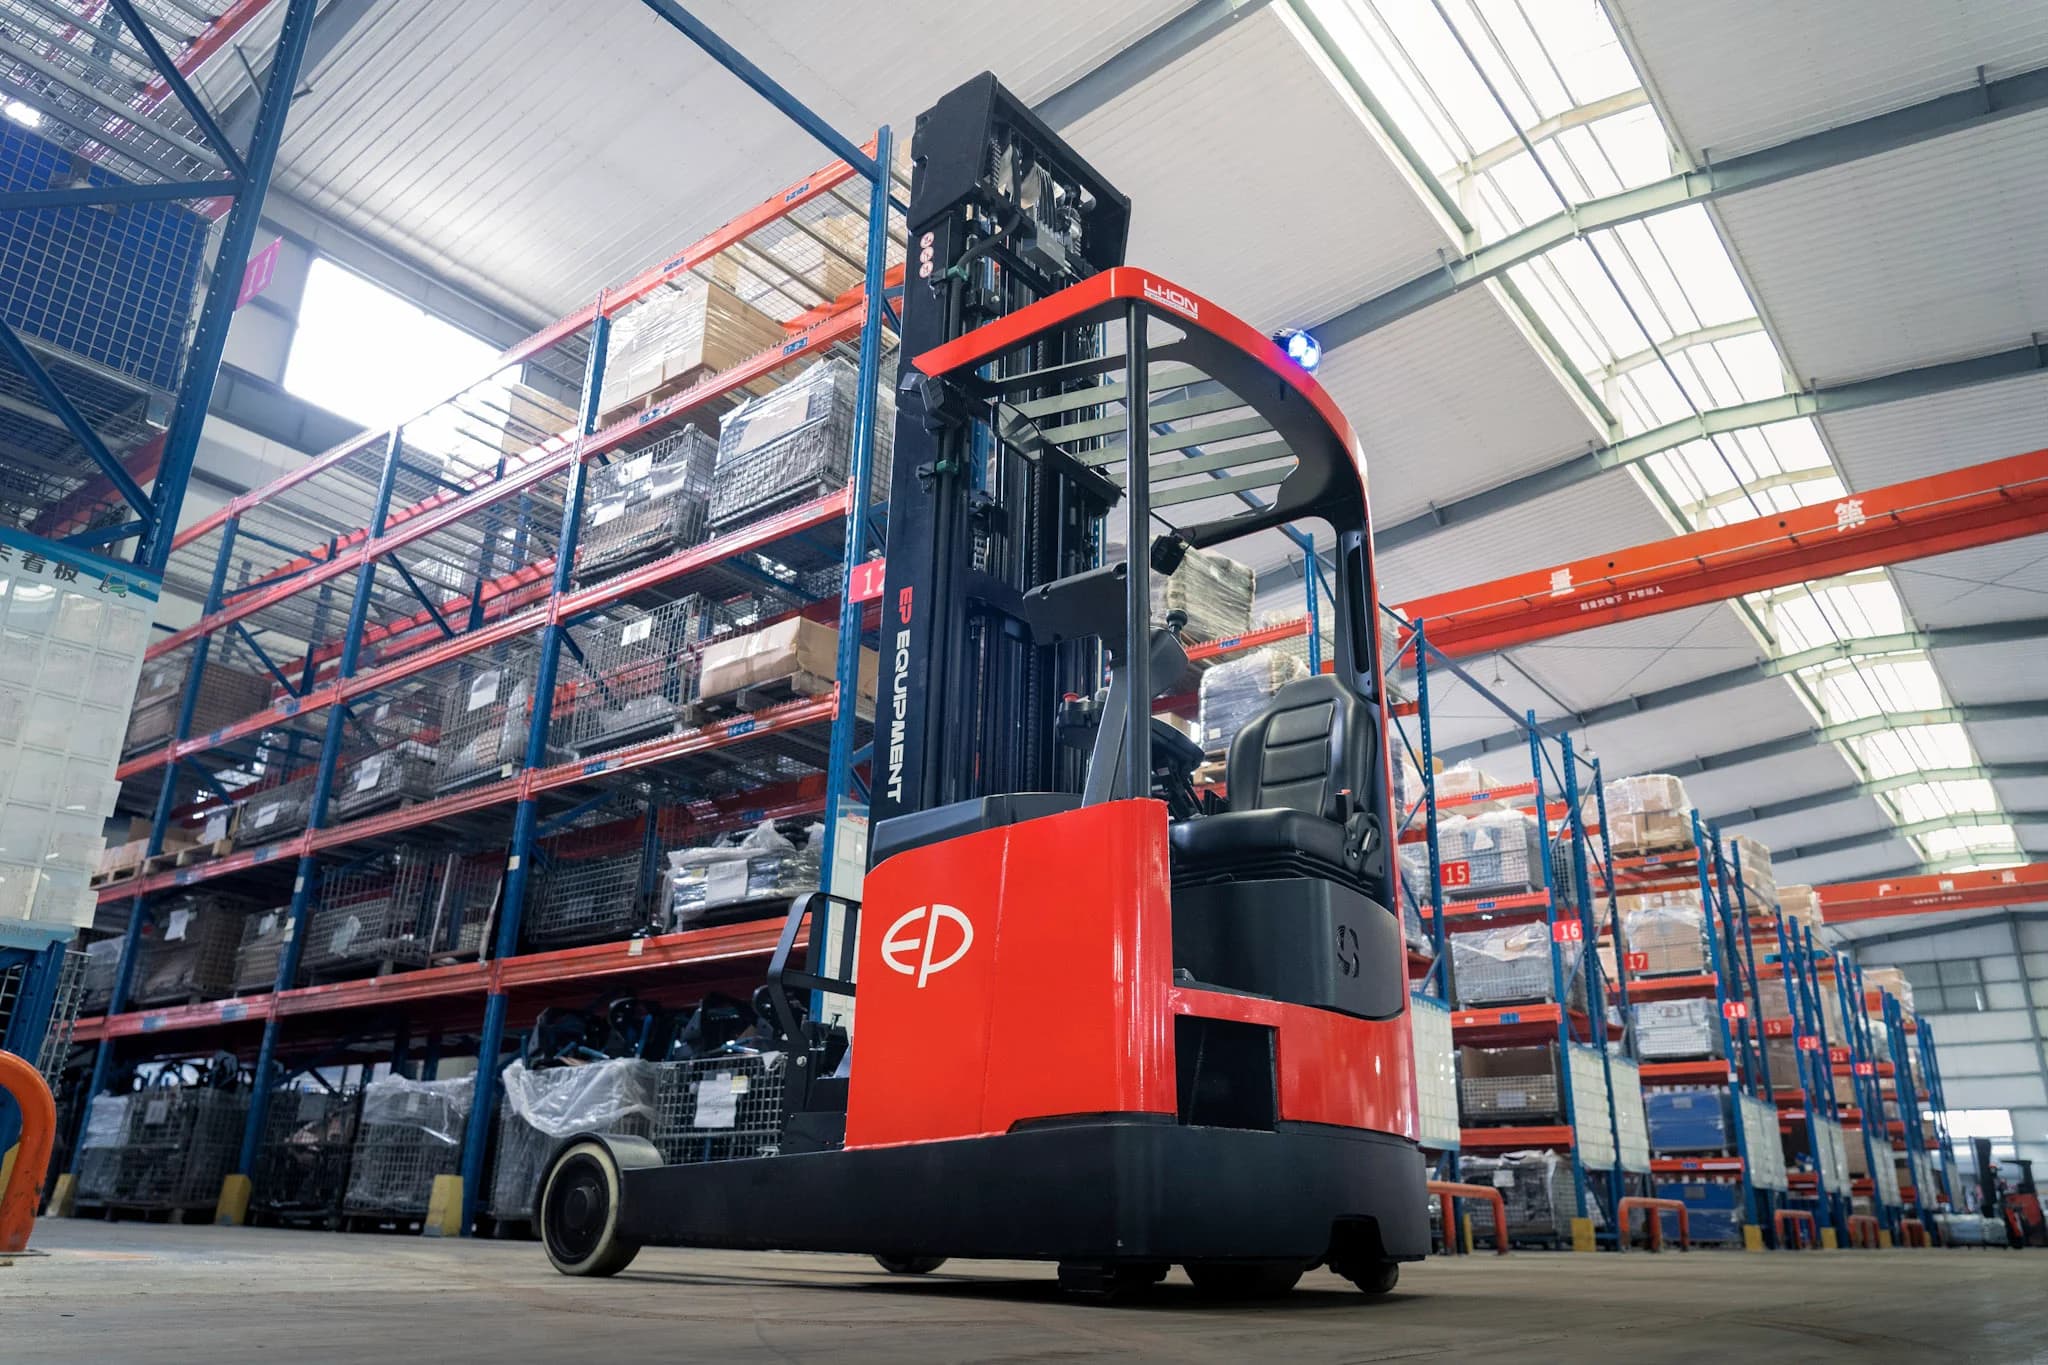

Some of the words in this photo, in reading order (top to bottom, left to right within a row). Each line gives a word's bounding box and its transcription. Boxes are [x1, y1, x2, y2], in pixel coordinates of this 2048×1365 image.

[1143, 278, 1199, 316] LI-ION
[1834, 499, 1867, 534] 第
[898, 586, 914, 625] EP
[886, 629, 911, 805] EQUIPMENT
[1445, 864, 1468, 885] 15
[1559, 922, 1581, 940] 16
[881, 903, 974, 989] EP
[1627, 956, 1646, 970] 17
[1729, 1003, 1747, 1018] 18
[1767, 1021, 1782, 1035] 19
[1831, 1051, 1845, 1063] 21
